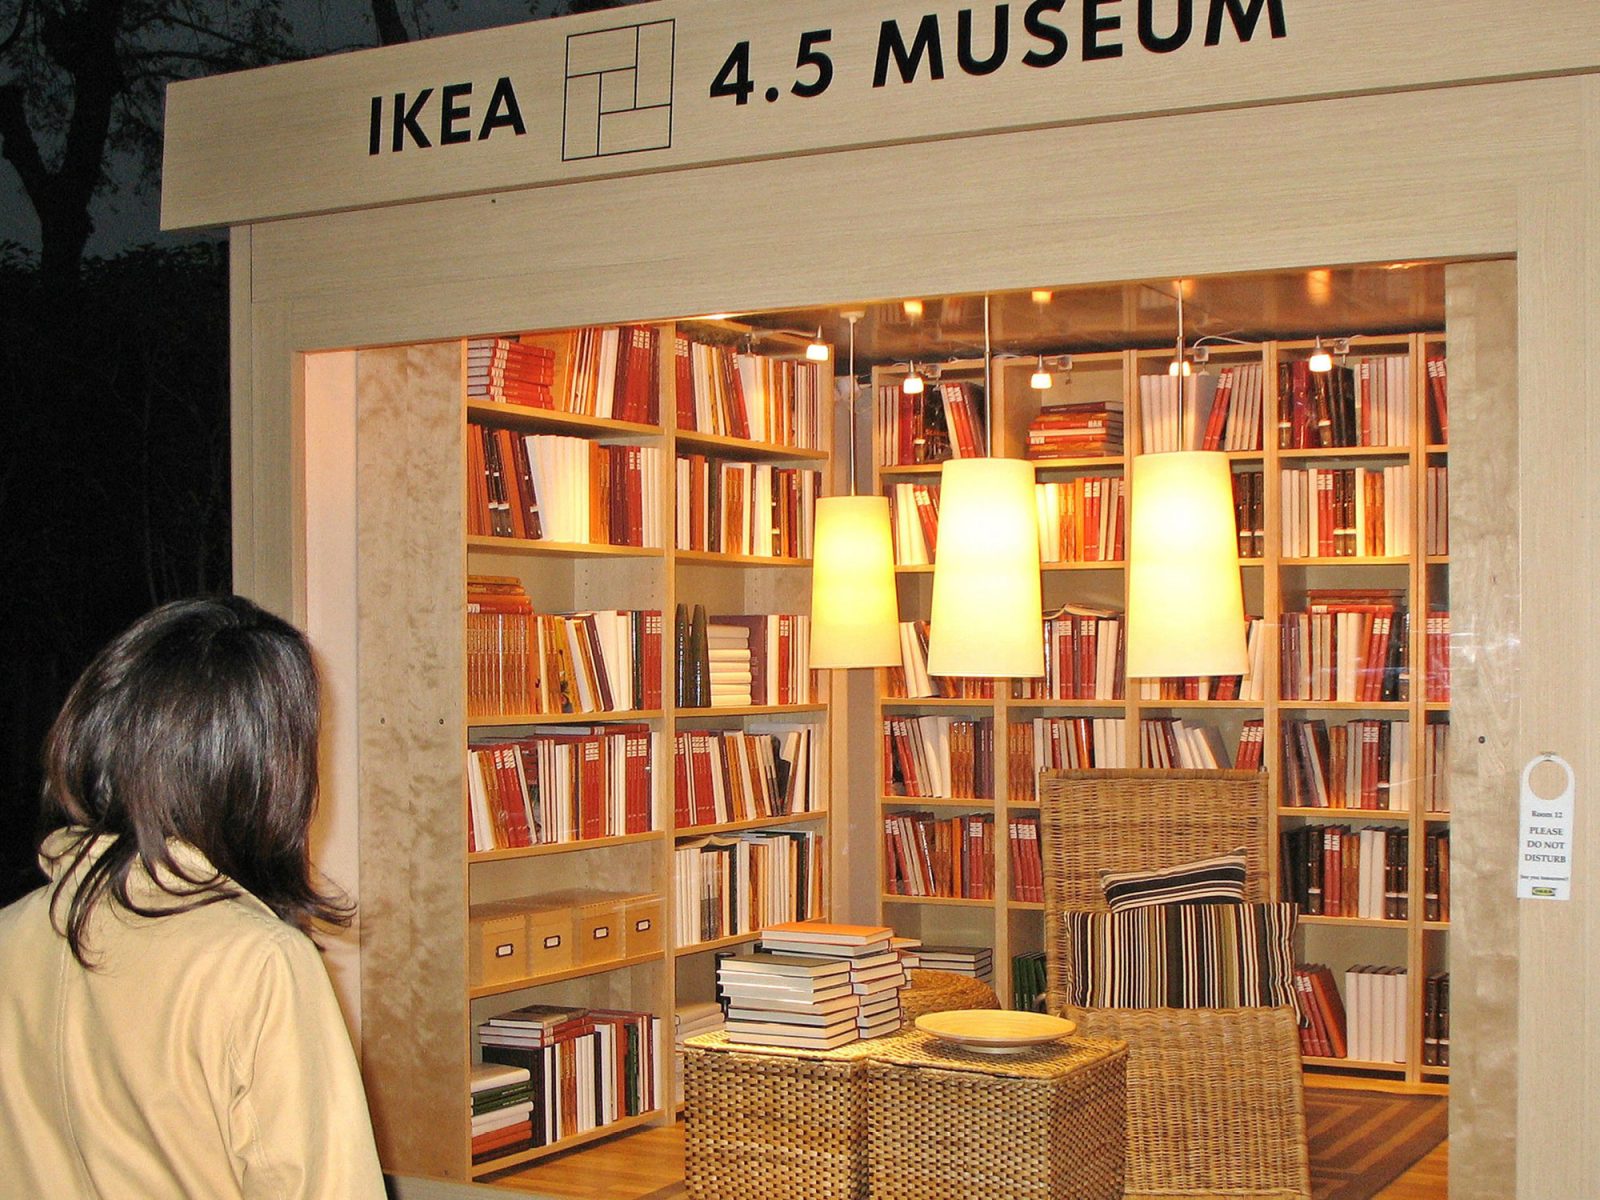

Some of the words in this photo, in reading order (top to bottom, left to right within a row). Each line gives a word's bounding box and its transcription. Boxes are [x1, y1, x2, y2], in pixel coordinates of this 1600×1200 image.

[369, 76, 527, 156] IKEA
[709, 29, 834, 106] 4.5
[872, 0, 1287, 88] MUSEUM
[1529, 826, 1564, 836] PLEASE
[1527, 840, 1542, 849] DO
[1544, 841, 1565, 849] NOT
[1524, 853, 1567, 864] DISTURB
